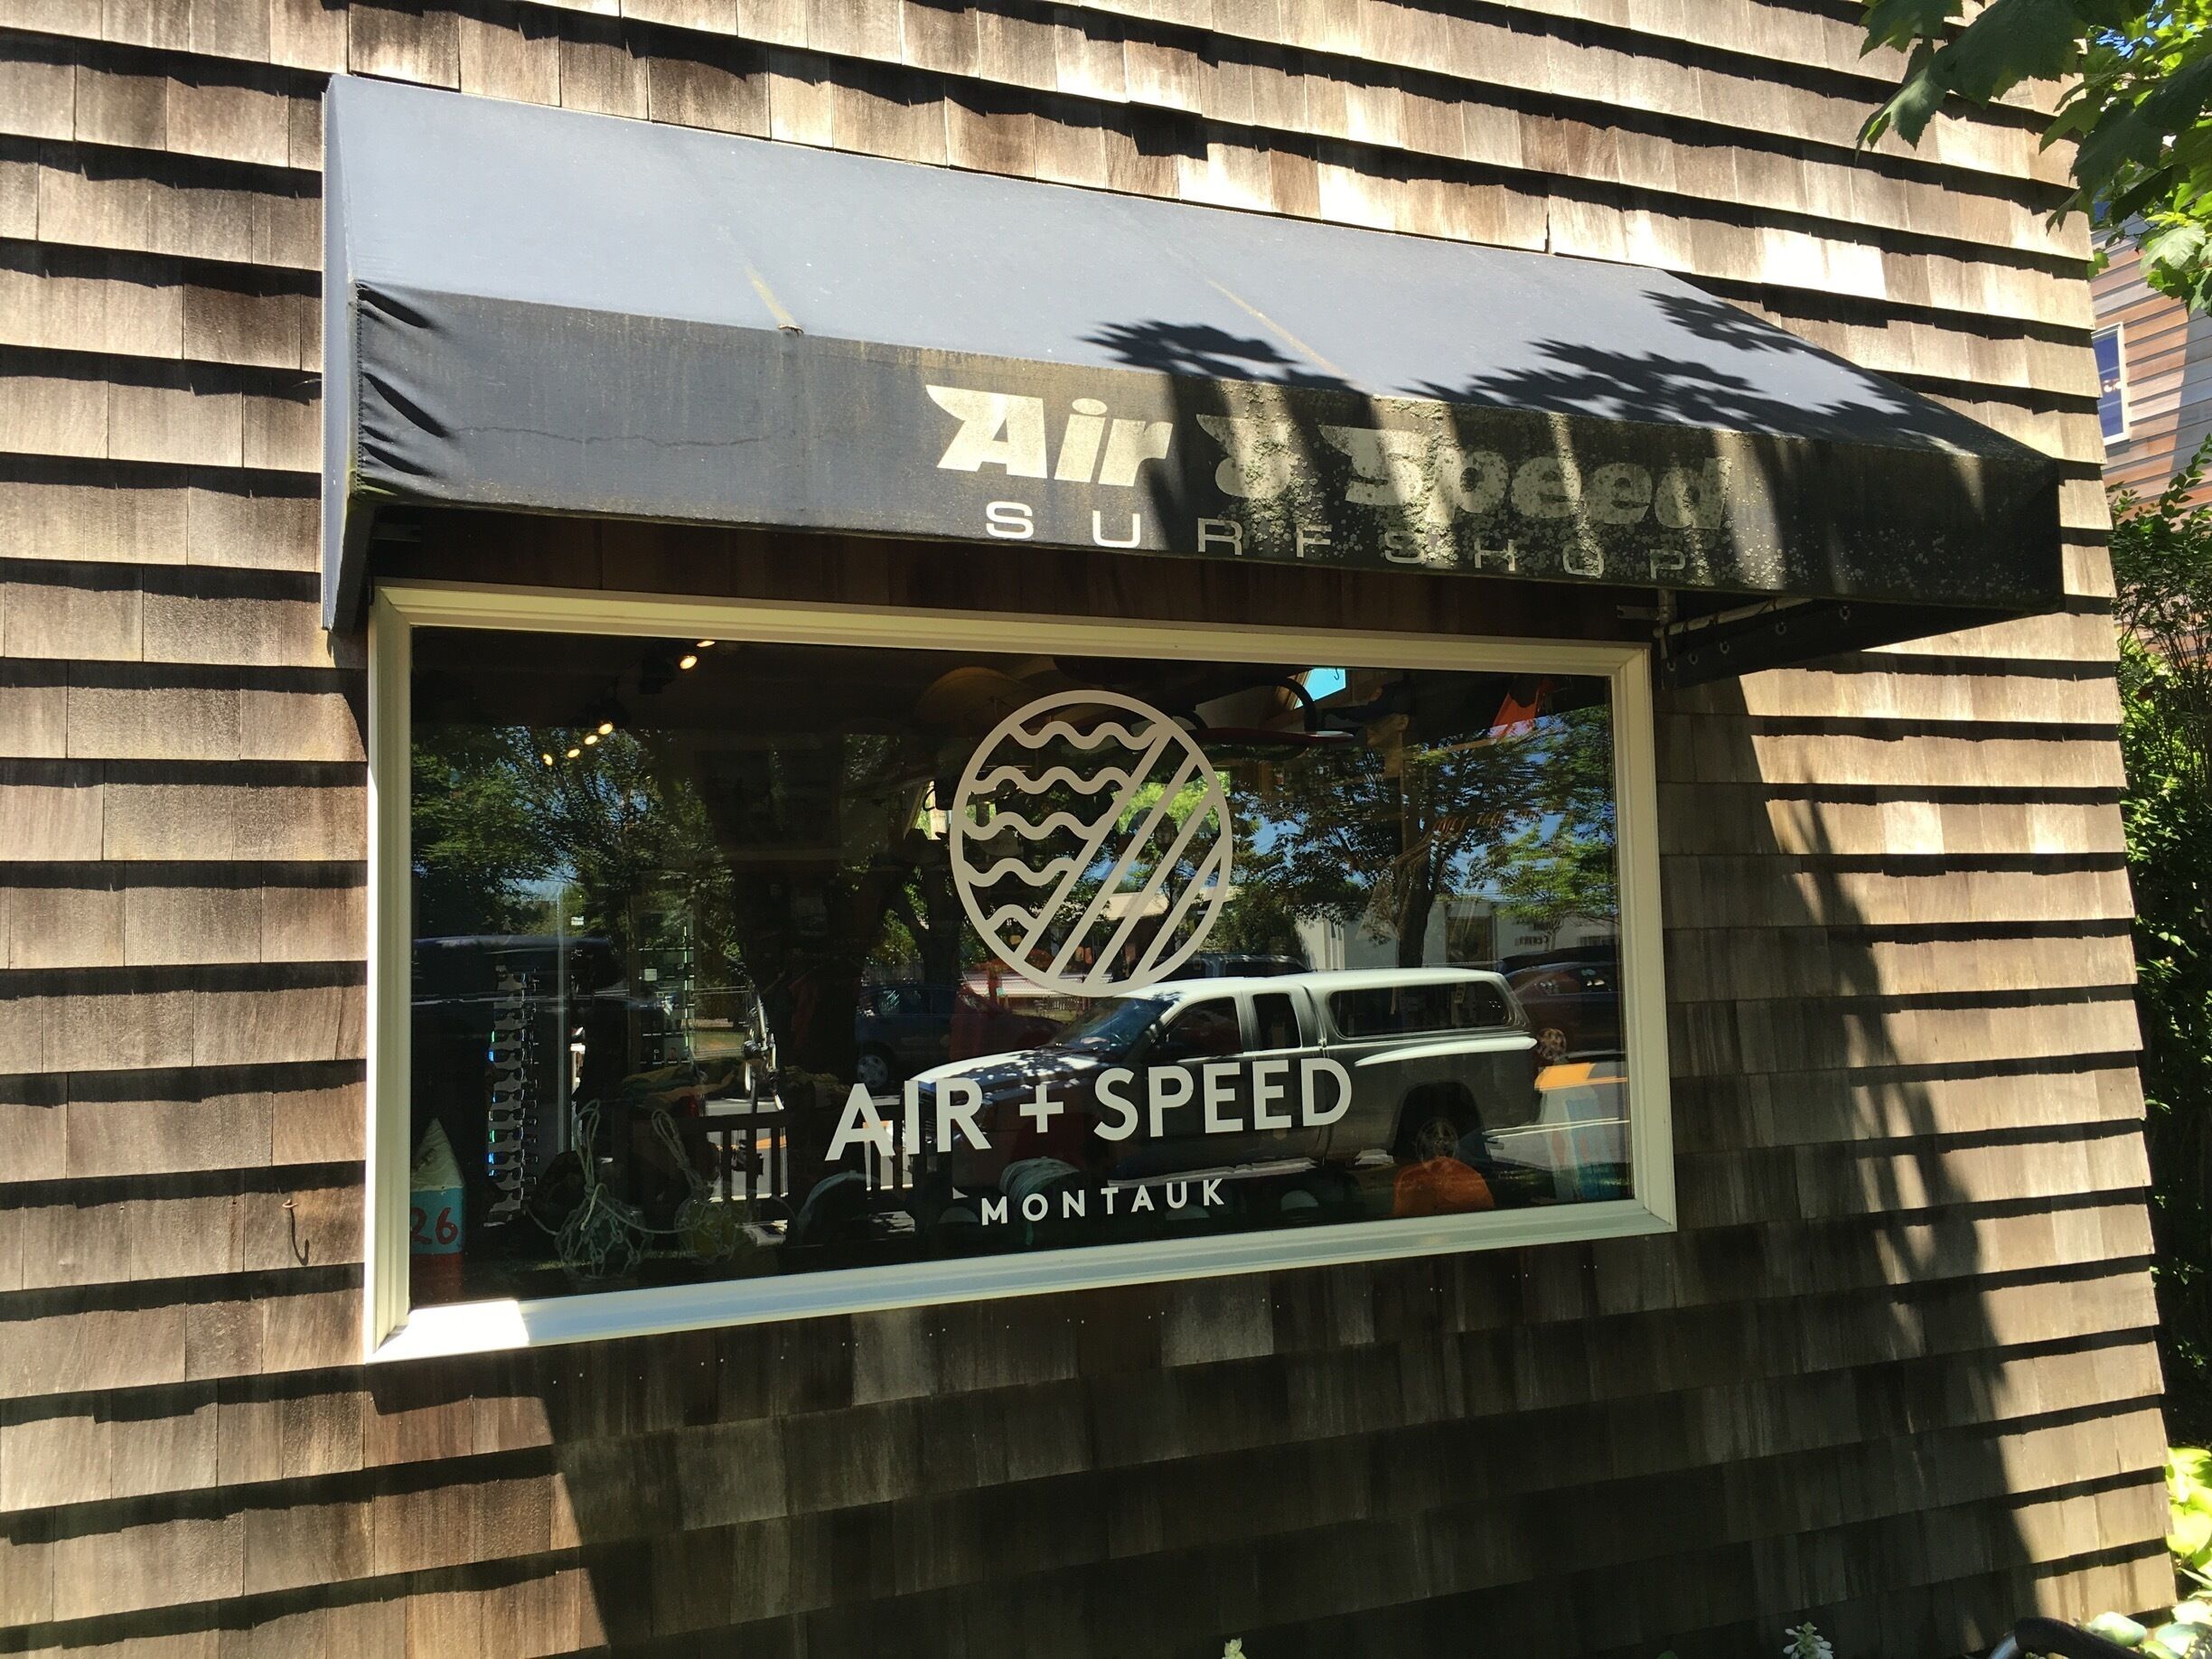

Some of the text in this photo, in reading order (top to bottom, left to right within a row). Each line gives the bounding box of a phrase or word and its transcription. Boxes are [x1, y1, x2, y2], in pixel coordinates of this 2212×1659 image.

[925, 384, 1174, 487] Air
[1317, 425, 1731, 530] Speed
[824, 1077, 992, 1161] AIR
[1093, 1056, 1354, 1141] SPEED
[410, 1206, 459, 1246] 26
[980, 1177, 1225, 1226] MONTAUK
